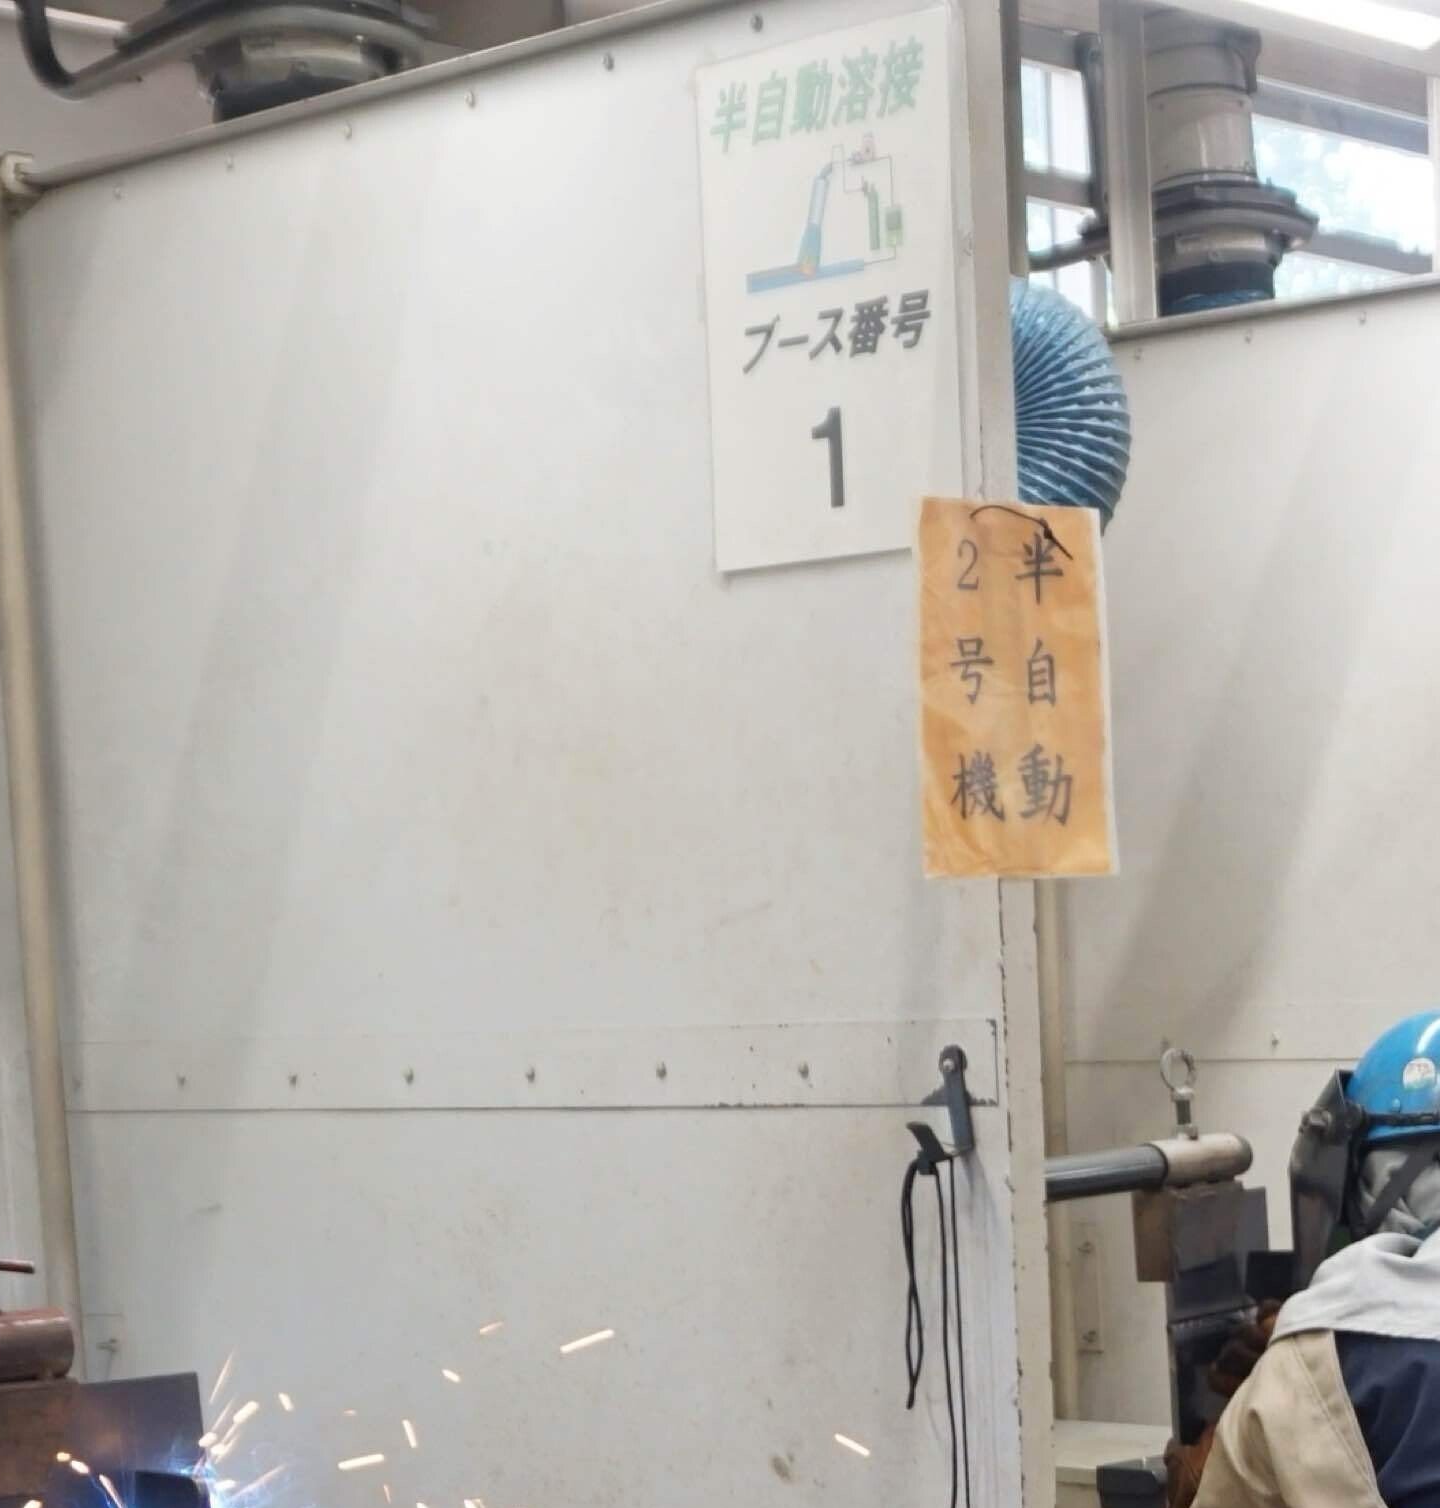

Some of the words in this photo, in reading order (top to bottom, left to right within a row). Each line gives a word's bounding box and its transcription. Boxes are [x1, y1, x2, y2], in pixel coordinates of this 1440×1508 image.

[709, 37, 925, 155] 半自動溶接
[742, 288, 932, 376] ブース番号
[810, 406, 845, 508] 1
[949, 540, 1006, 822] 2号機
[1015, 519, 1072, 825] 半自動
